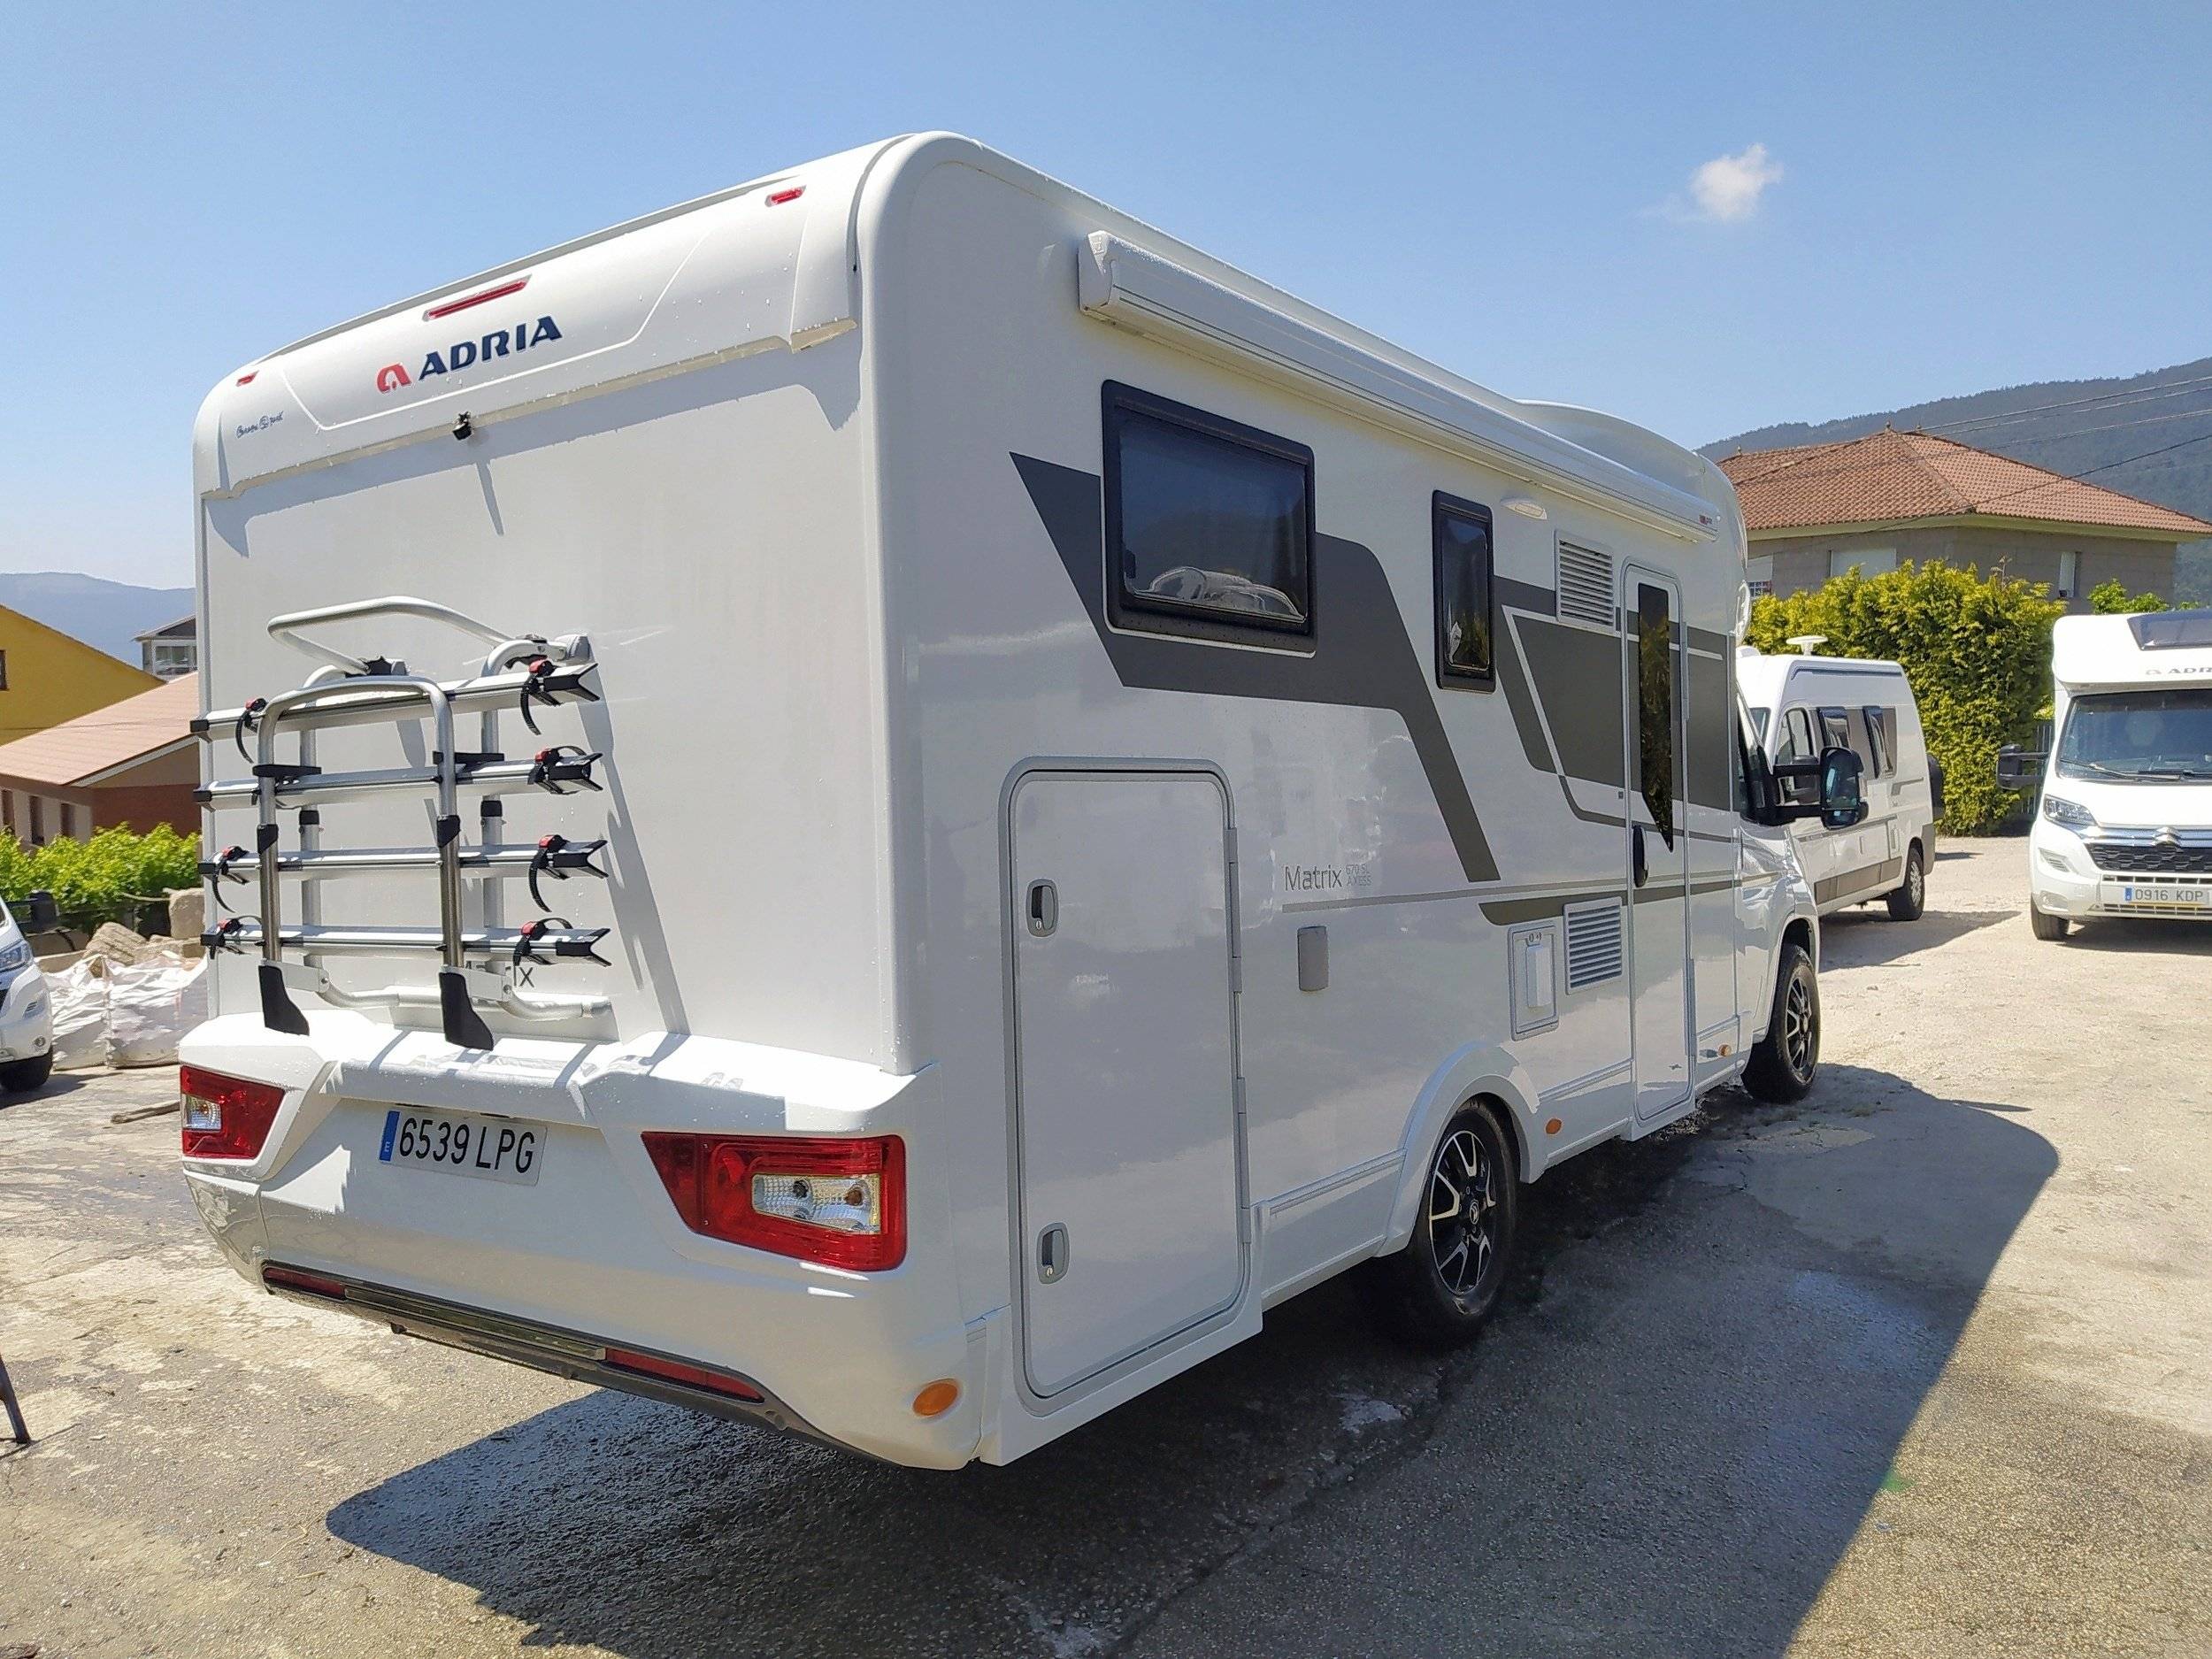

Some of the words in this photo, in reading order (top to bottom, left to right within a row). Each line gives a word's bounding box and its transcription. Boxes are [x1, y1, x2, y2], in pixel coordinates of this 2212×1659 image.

[419, 315, 563, 380] ADRIA
[1285, 864, 1343, 891] Matrix
[2135, 888, 2169, 901] 0916
[2177, 889, 2203, 902] KDP
[399, 1118, 470, 1164] 6539
[475, 1125, 535, 1173] LPG
